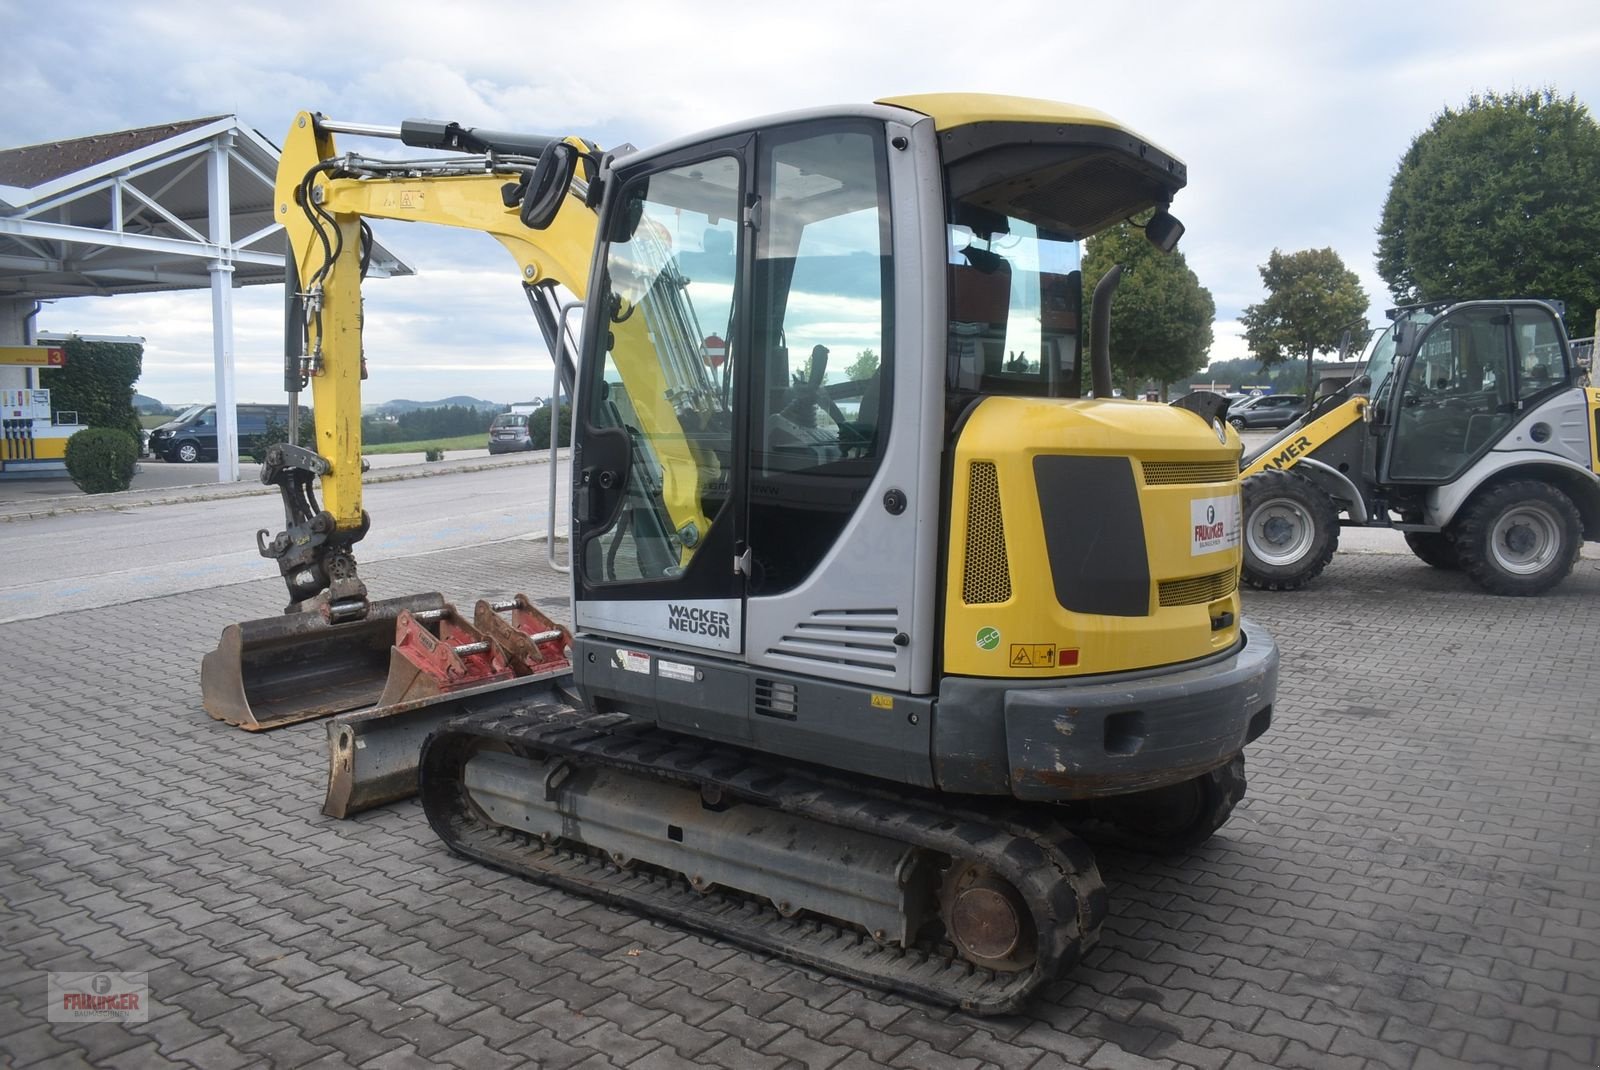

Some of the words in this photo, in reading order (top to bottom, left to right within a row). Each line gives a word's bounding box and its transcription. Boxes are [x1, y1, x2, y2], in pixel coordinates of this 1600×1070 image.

[52, 351, 62, 364] 3
[668, 604, 730, 625] WACKER
[669, 617, 730, 639] NEUSON
[976, 630, 999, 647] ECO
